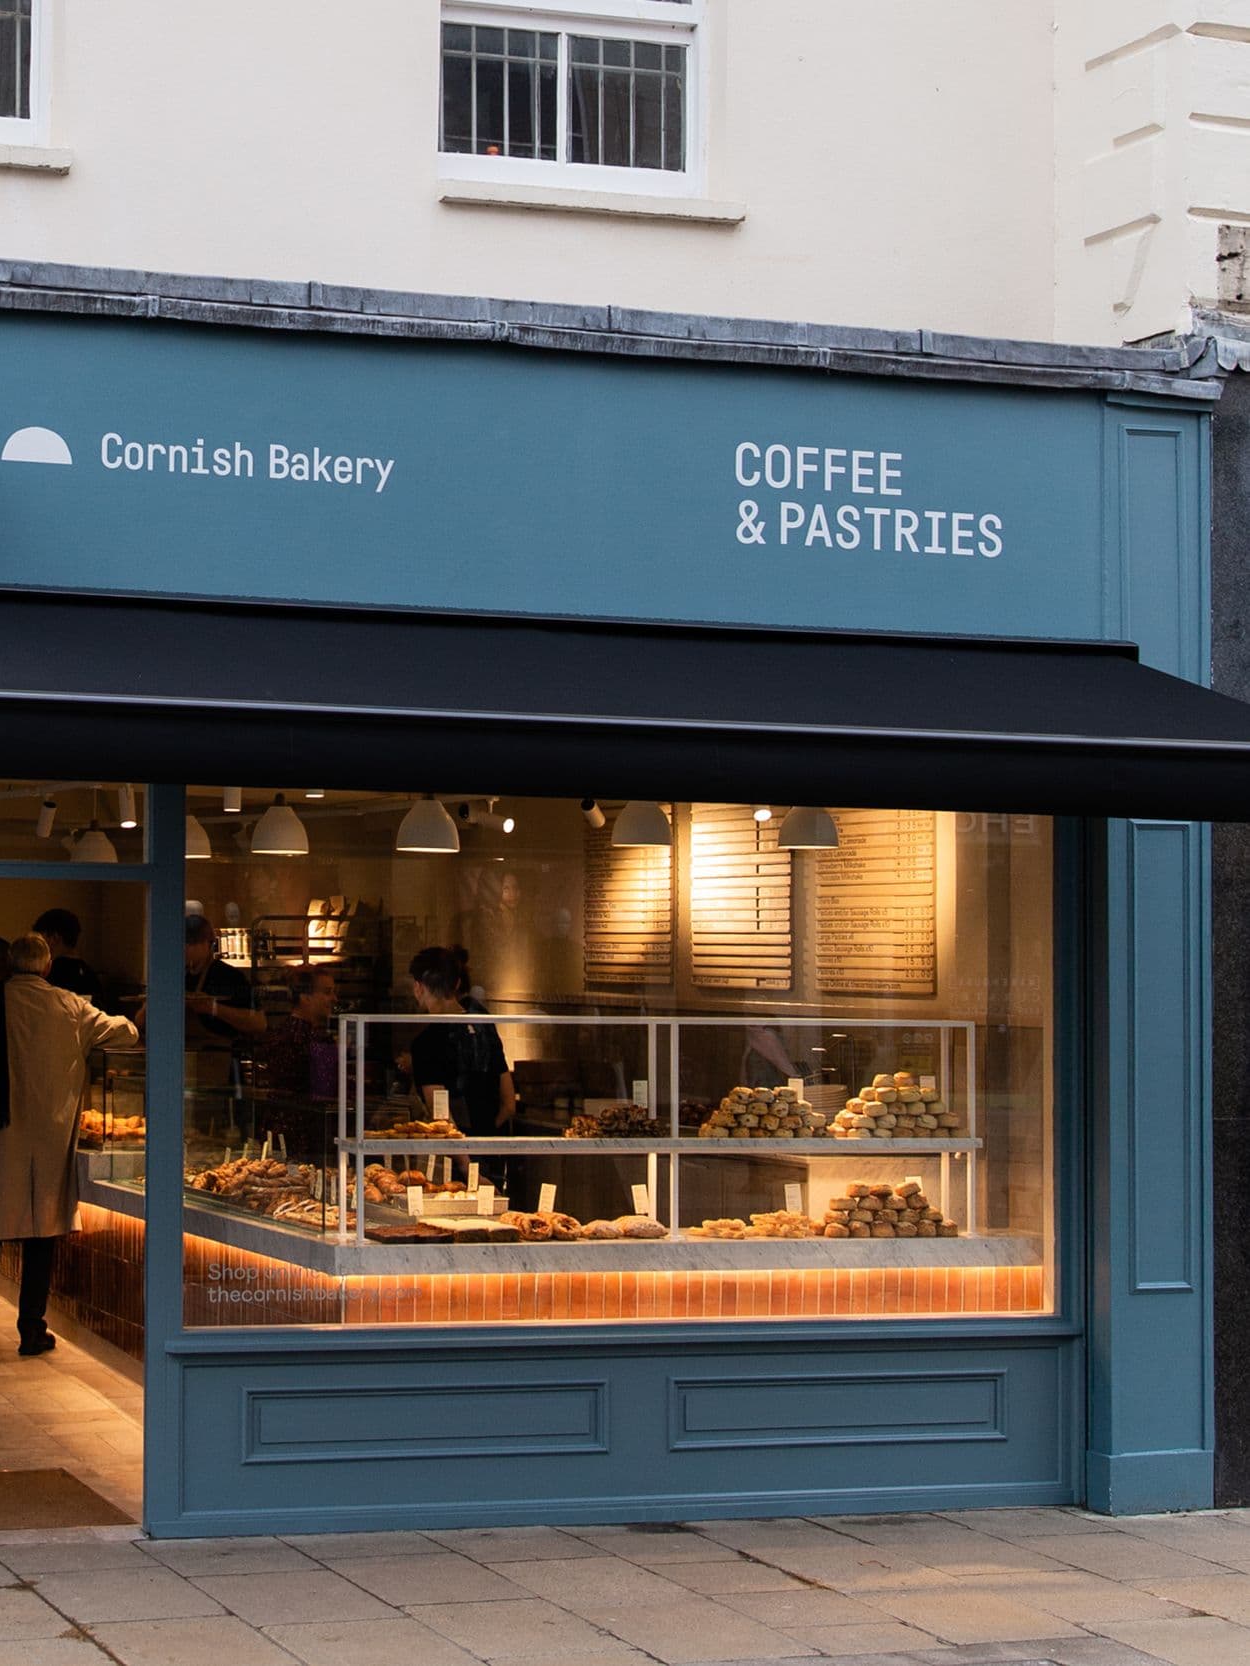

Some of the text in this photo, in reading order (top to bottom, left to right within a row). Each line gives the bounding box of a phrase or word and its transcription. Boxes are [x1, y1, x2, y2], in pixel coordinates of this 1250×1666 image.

[101, 432, 395, 493] Cornish Bakery
[735, 441, 902, 496] COFFEE
[735, 499, 1003, 559] & PASTRIES
[207, 1263, 258, 1285] Shop
